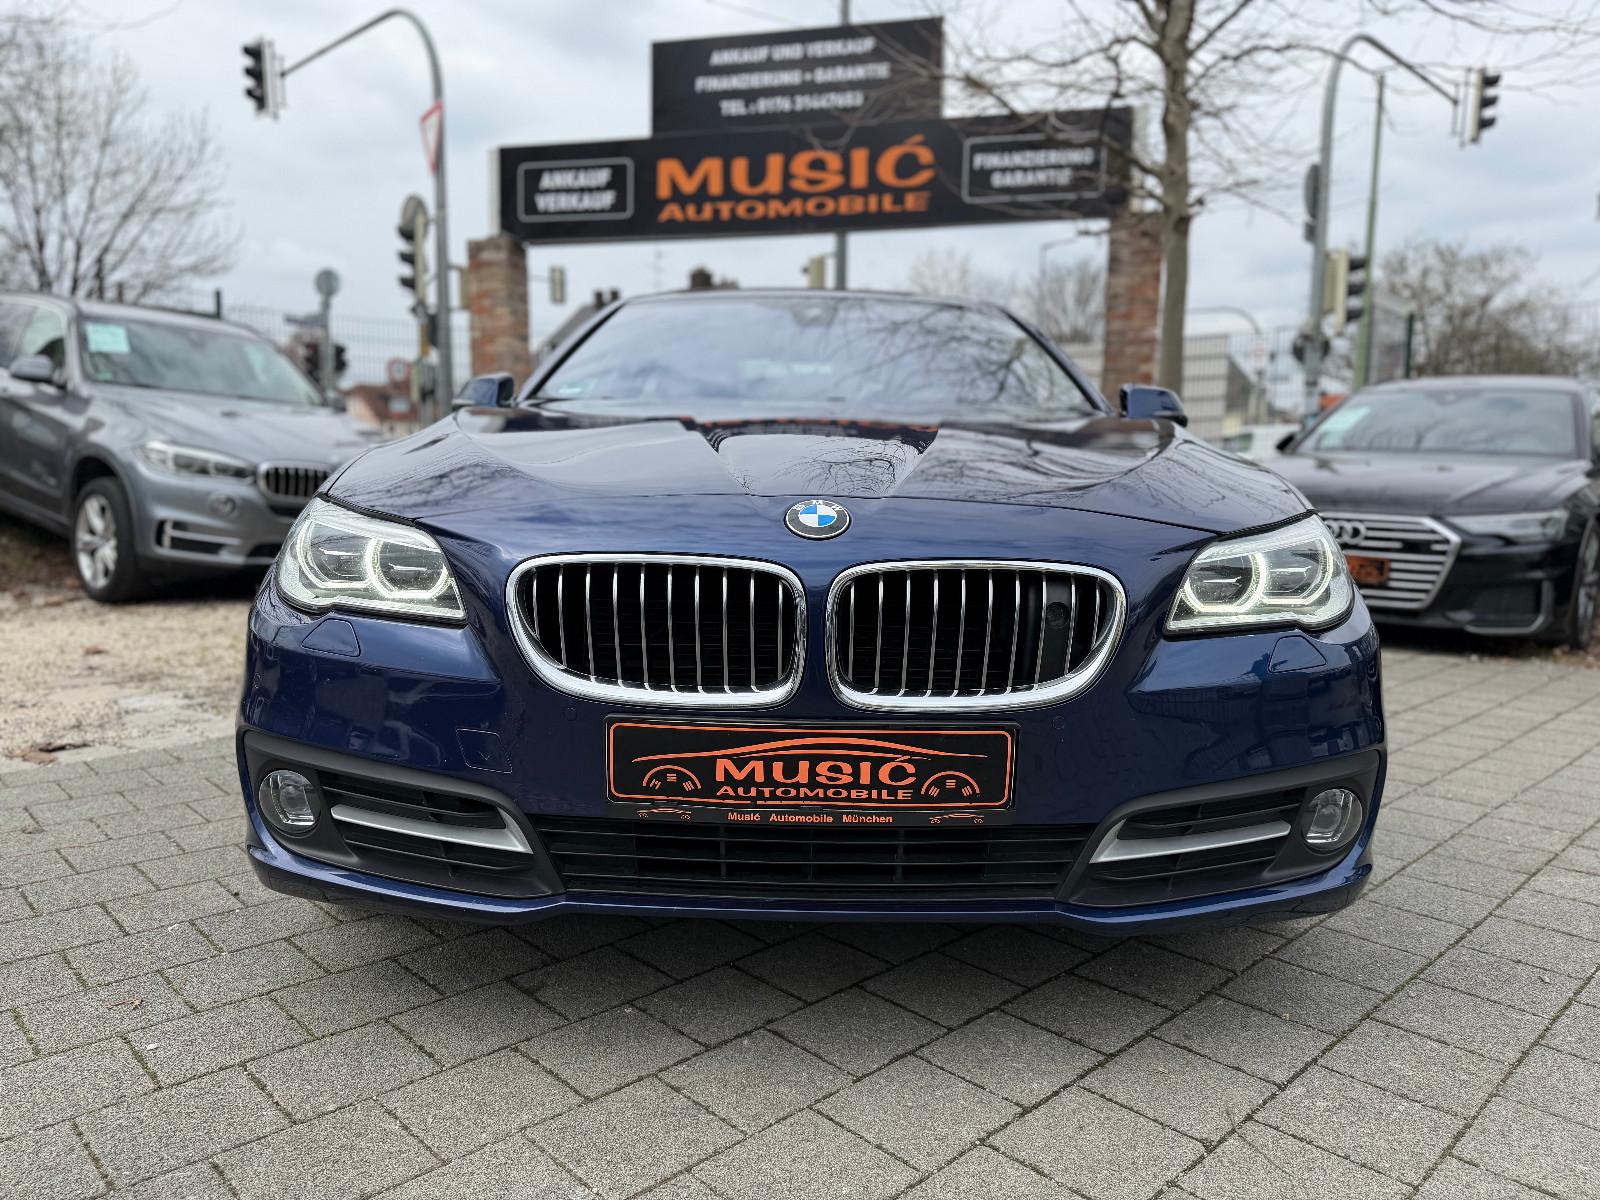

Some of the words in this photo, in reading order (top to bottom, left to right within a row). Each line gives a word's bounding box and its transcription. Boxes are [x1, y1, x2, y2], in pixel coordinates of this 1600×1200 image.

[709, 46, 770, 66] ANKAUF
[771, 43, 804, 61] UND
[806, 37, 877, 58] VERKAUF
[694, 69, 802, 93] FINANZIERUNG
[814, 62, 891, 84] GARANTIE
[656, 134, 937, 200] MUSIĆ
[972, 146, 1094, 171] FINANZIERUNG
[538, 167, 612, 192] ANKAUF
[990, 166, 1074, 189] GARANTIE
[534, 189, 617, 213] VERKAUF
[656, 191, 931, 222] AUTOMOBILE
[714, 755, 917, 786] MUSIĆ
[716, 785, 914, 800] AUTOMOBILE
[769, 813, 833, 823] Automobile
[842, 814, 893, 824] München
